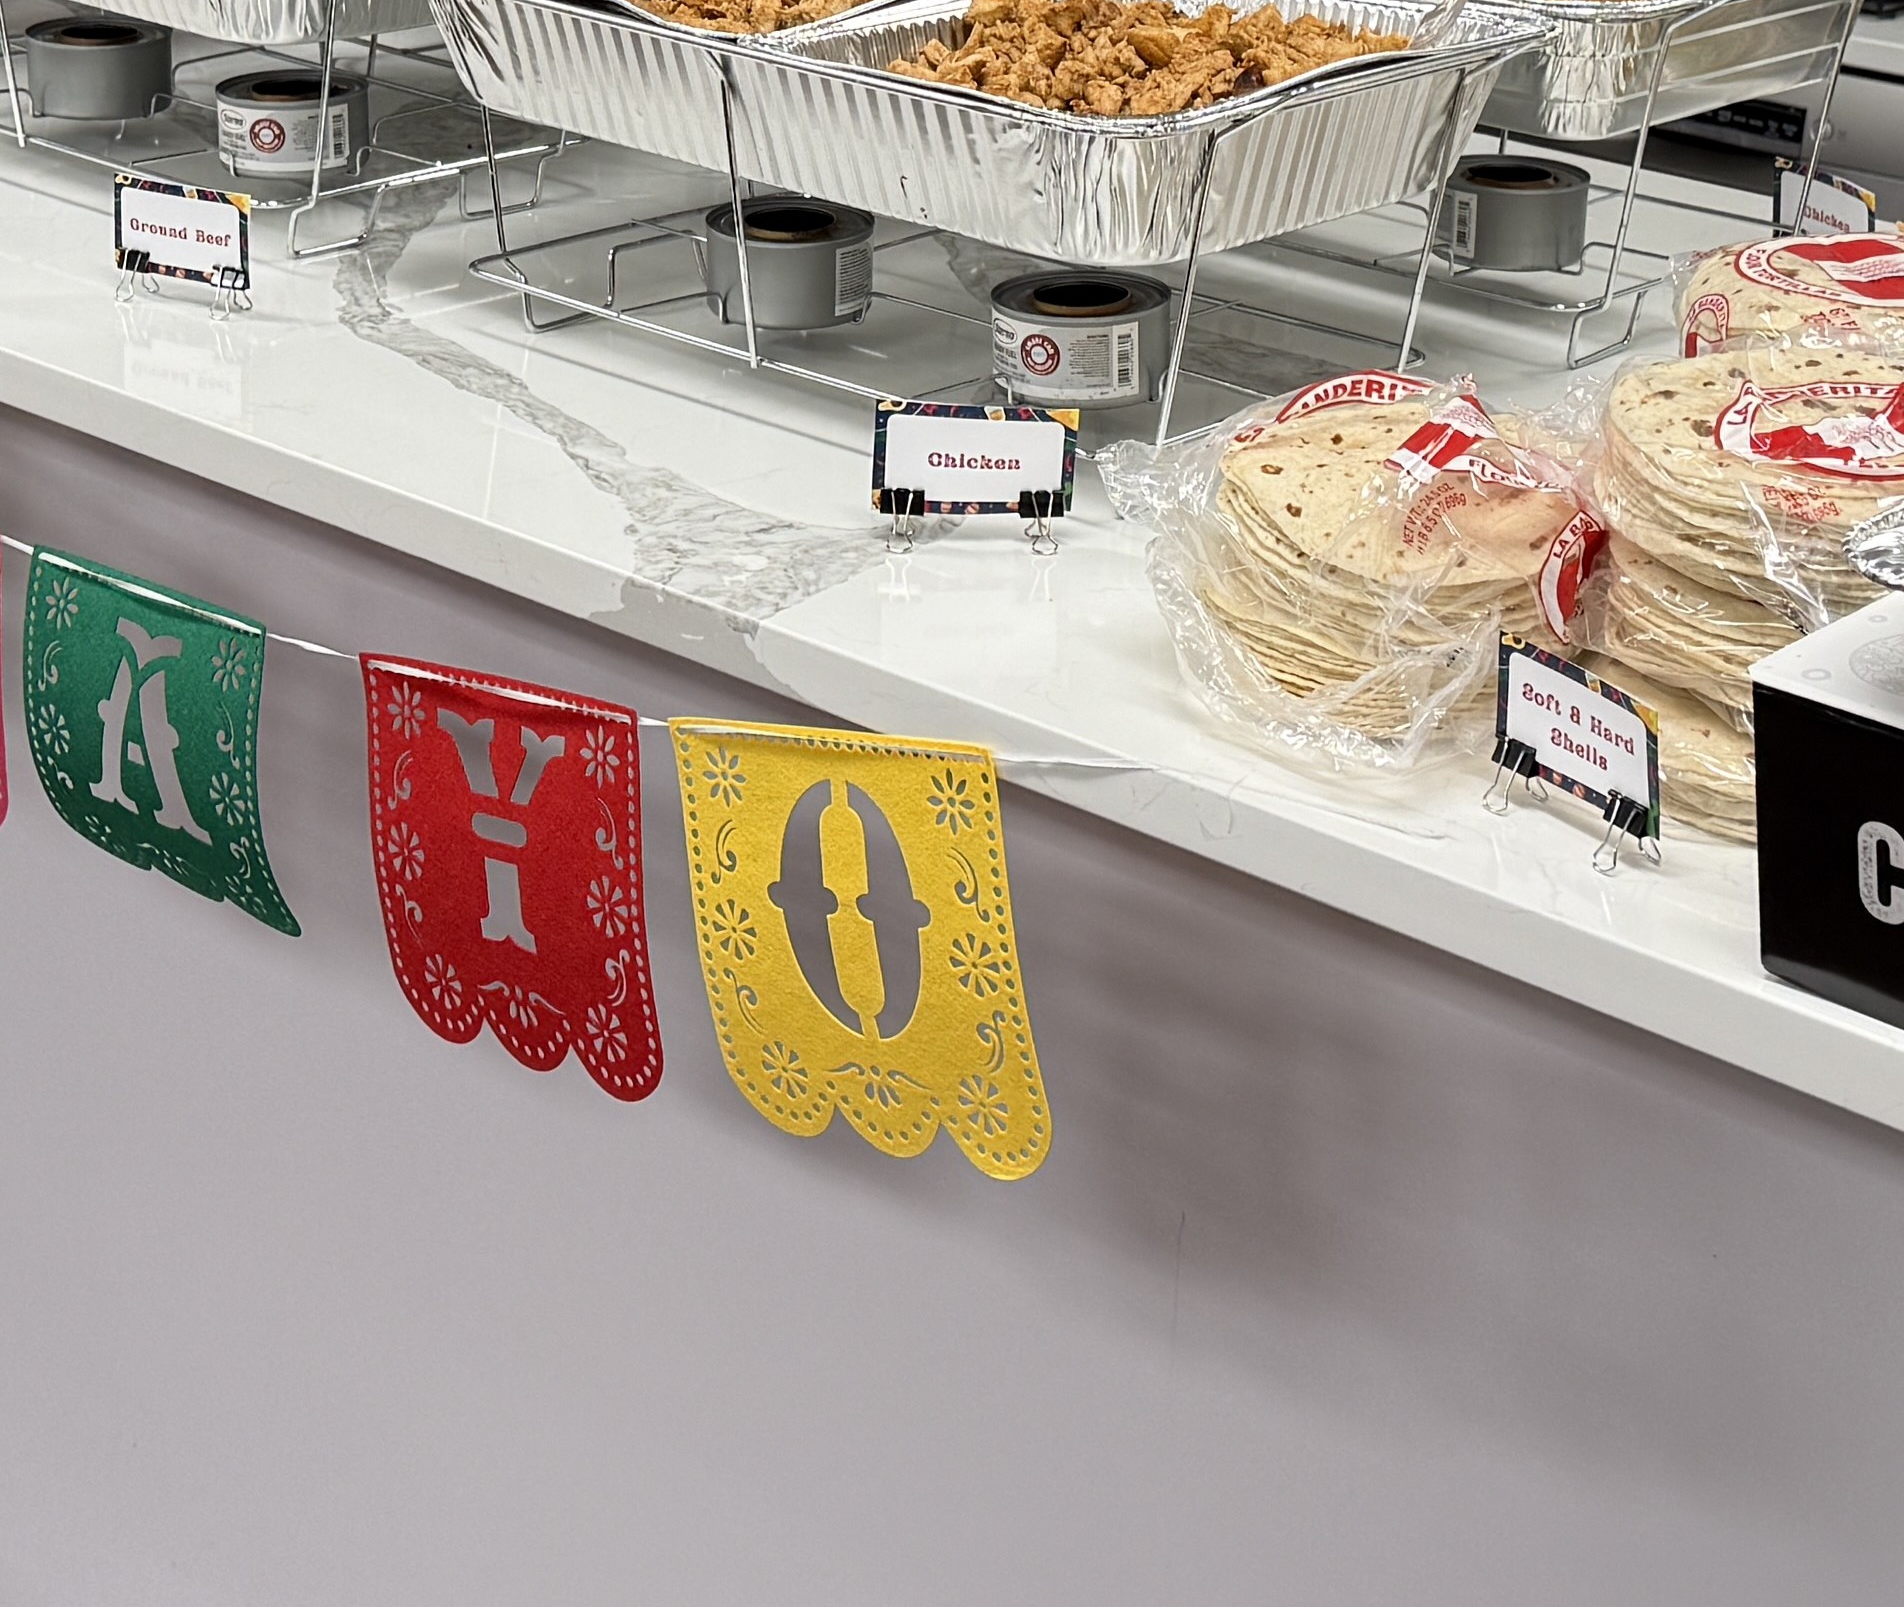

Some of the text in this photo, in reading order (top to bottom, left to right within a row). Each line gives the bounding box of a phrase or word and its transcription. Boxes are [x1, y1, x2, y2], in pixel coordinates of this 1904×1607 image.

[129, 217, 232, 248] Ground Beef
[927, 451, 1021, 471] Chicken
[1521, 682, 1636, 756] Soft & Hard
[1550, 726, 1609, 773] Shells
